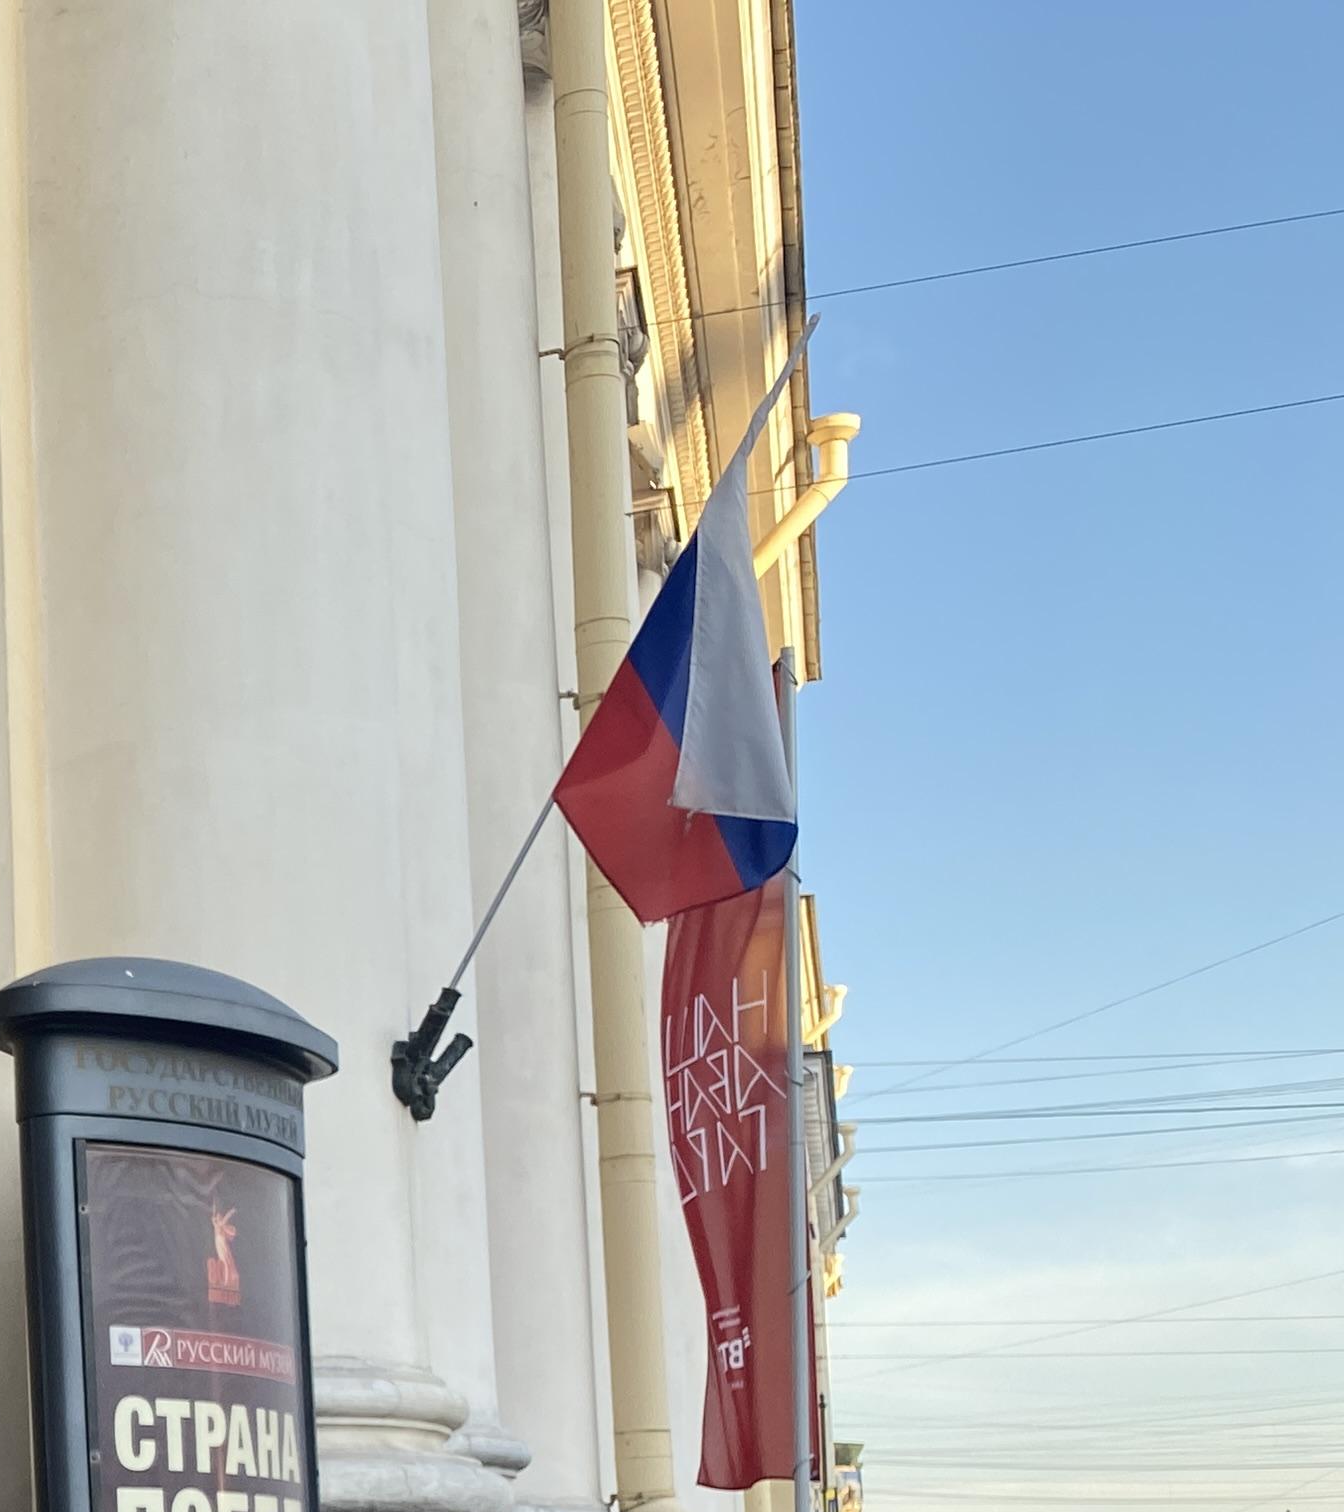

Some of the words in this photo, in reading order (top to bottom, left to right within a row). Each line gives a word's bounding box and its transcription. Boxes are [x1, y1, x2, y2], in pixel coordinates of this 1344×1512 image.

[108, 1084, 242, 1130] РУССКИЙ
[244, 1104, 298, 1142] МУЗЕЙ
[176, 1338, 256, 1369] РУССКИЙ
[114, 1395, 301, 1484] СТРАНА
